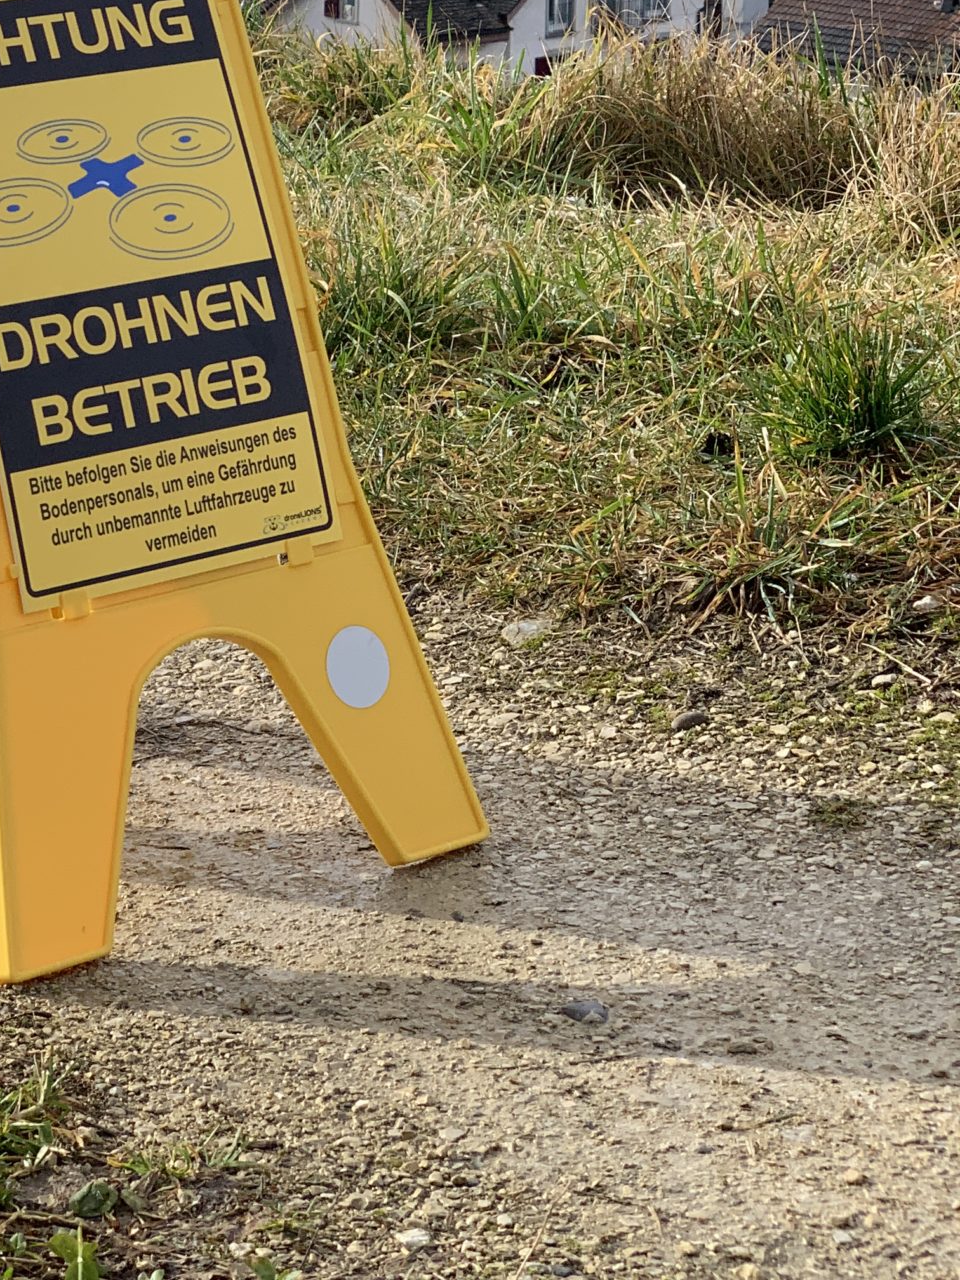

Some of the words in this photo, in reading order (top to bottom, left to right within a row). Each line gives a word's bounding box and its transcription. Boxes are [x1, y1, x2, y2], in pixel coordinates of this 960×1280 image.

[31, 355, 272, 447] BETRIEB
[28, 475, 63, 496] Bitte
[65, 463, 127, 488] befolgen
[129, 455, 153, 474] Sie
[156, 450, 177, 469] die
[181, 432, 270, 464] Anweisungen
[273, 425, 297, 443] des
[40, 481, 159, 521] Bodenpersonals,
[162, 477, 184, 495] um
[186, 471, 215, 489] eine
[218, 453, 297, 482] Gefährdung
[51, 521, 93, 546] durch
[96, 503, 182, 537] unbemannte
[185, 485, 277, 517] Luftfahrzeuge
[279, 479, 296, 496] zu
[144, 524, 217, 552] vermeiden
